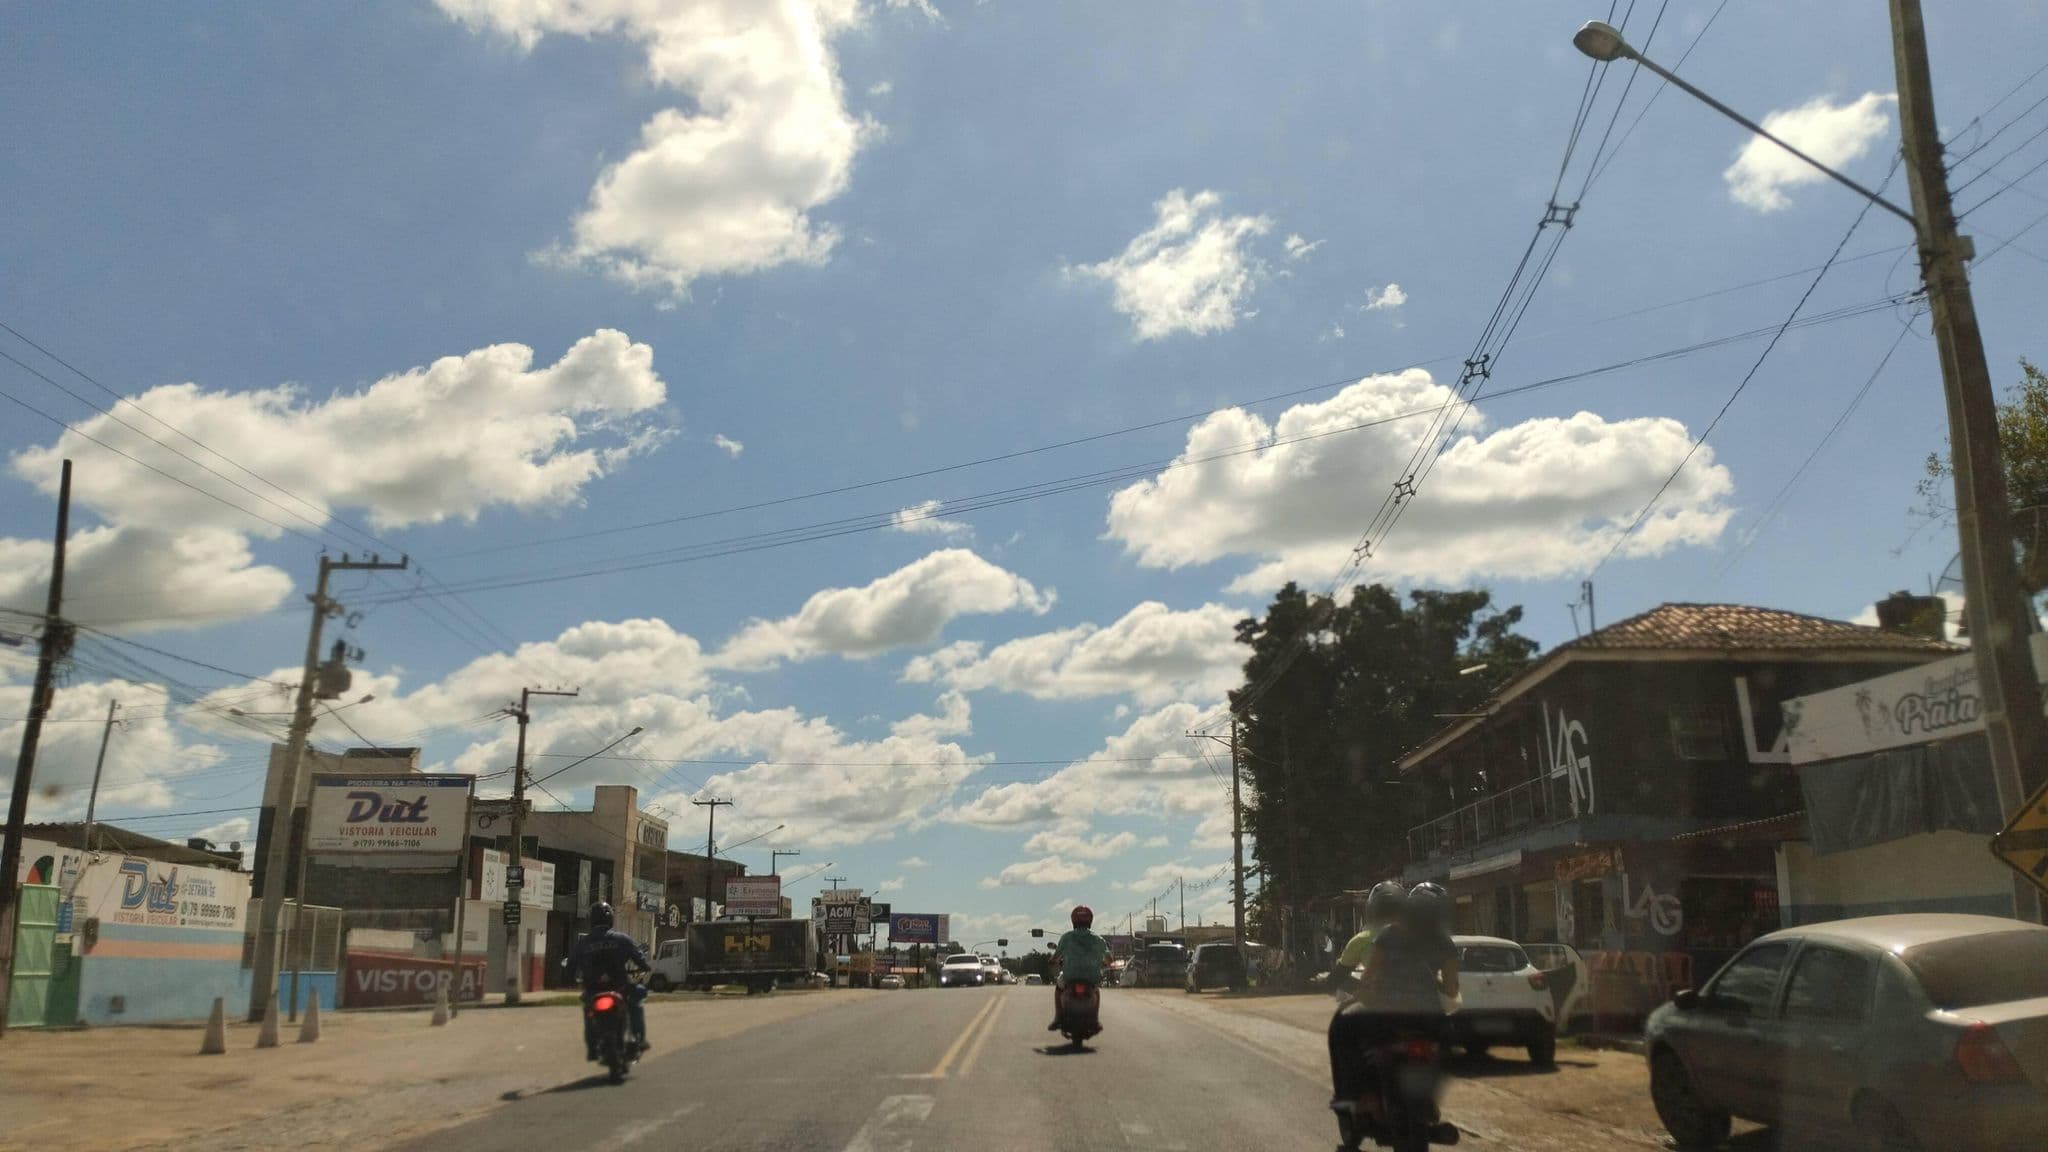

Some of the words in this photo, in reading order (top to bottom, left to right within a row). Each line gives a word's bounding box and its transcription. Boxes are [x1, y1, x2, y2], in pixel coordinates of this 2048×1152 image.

[1895, 688, 1982, 735] Praia
[1543, 699, 1595, 819] LAG
[346, 791, 429, 823] Dut
[339, 826, 384, 837] VISTORIA
[390, 826, 437, 837] VEICULAR
[118, 856, 179, 914] Dut
[113, 911, 144, 923] VISTORIA
[829, 907, 853, 918] ACM
[1622, 872, 1683, 935] LAG
[356, 968, 475, 992] VISTORA
